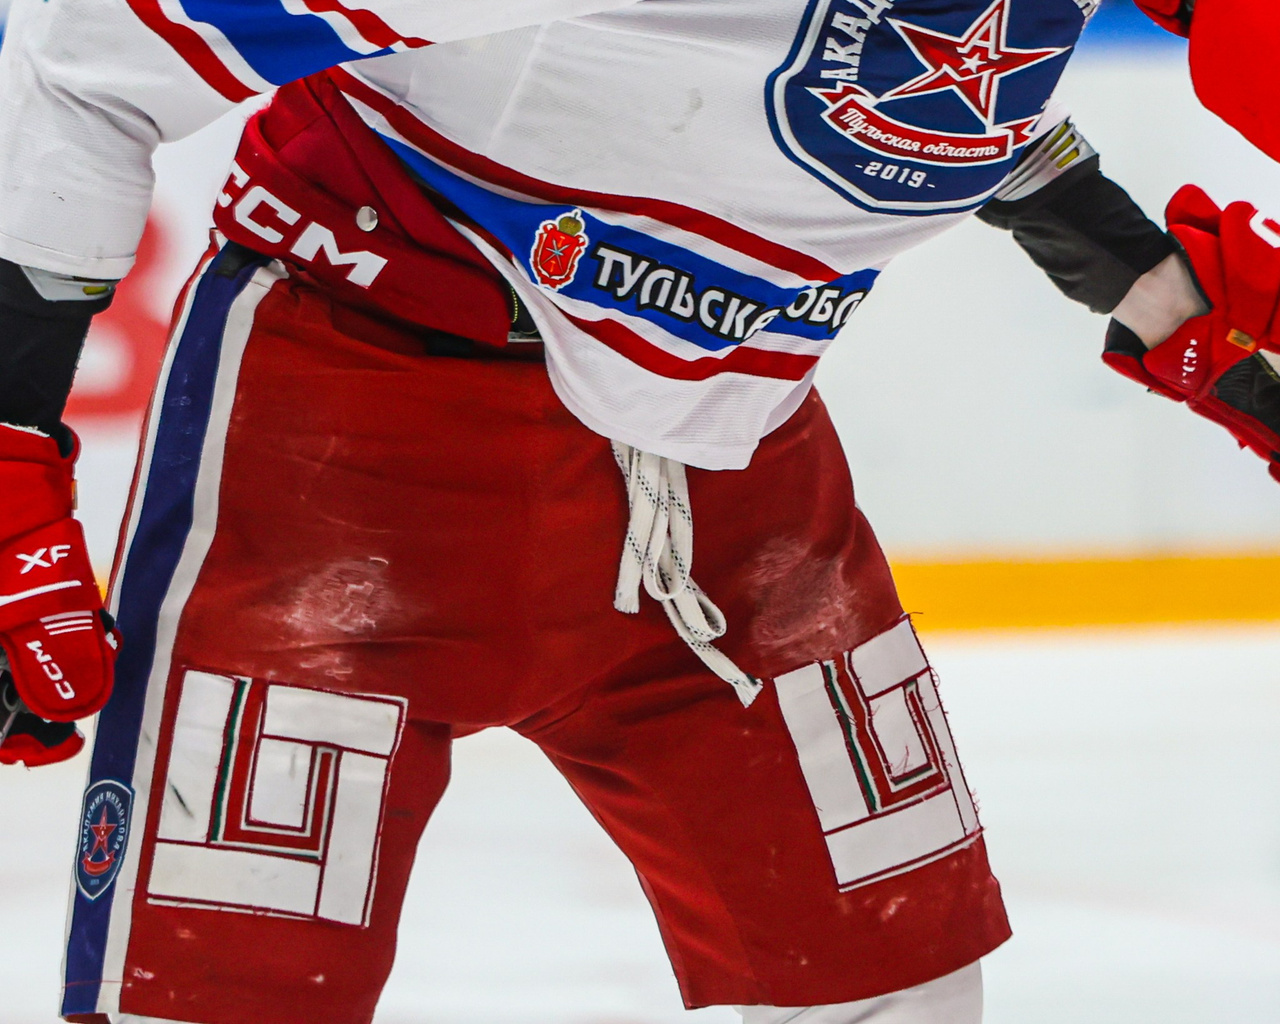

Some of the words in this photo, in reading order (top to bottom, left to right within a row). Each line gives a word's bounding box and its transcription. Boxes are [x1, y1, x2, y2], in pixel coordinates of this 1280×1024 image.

[838, 107, 920, 153] Тульская
[922, 143, 1000, 159] область
[217, 159, 389, 289] CCM
[595, 247, 782, 341] ТУЛЬСКА
[785, 288, 864, 329] ОБЛ
[15, 544, 71, 575] XF
[26, 640, 76, 700] CCM
